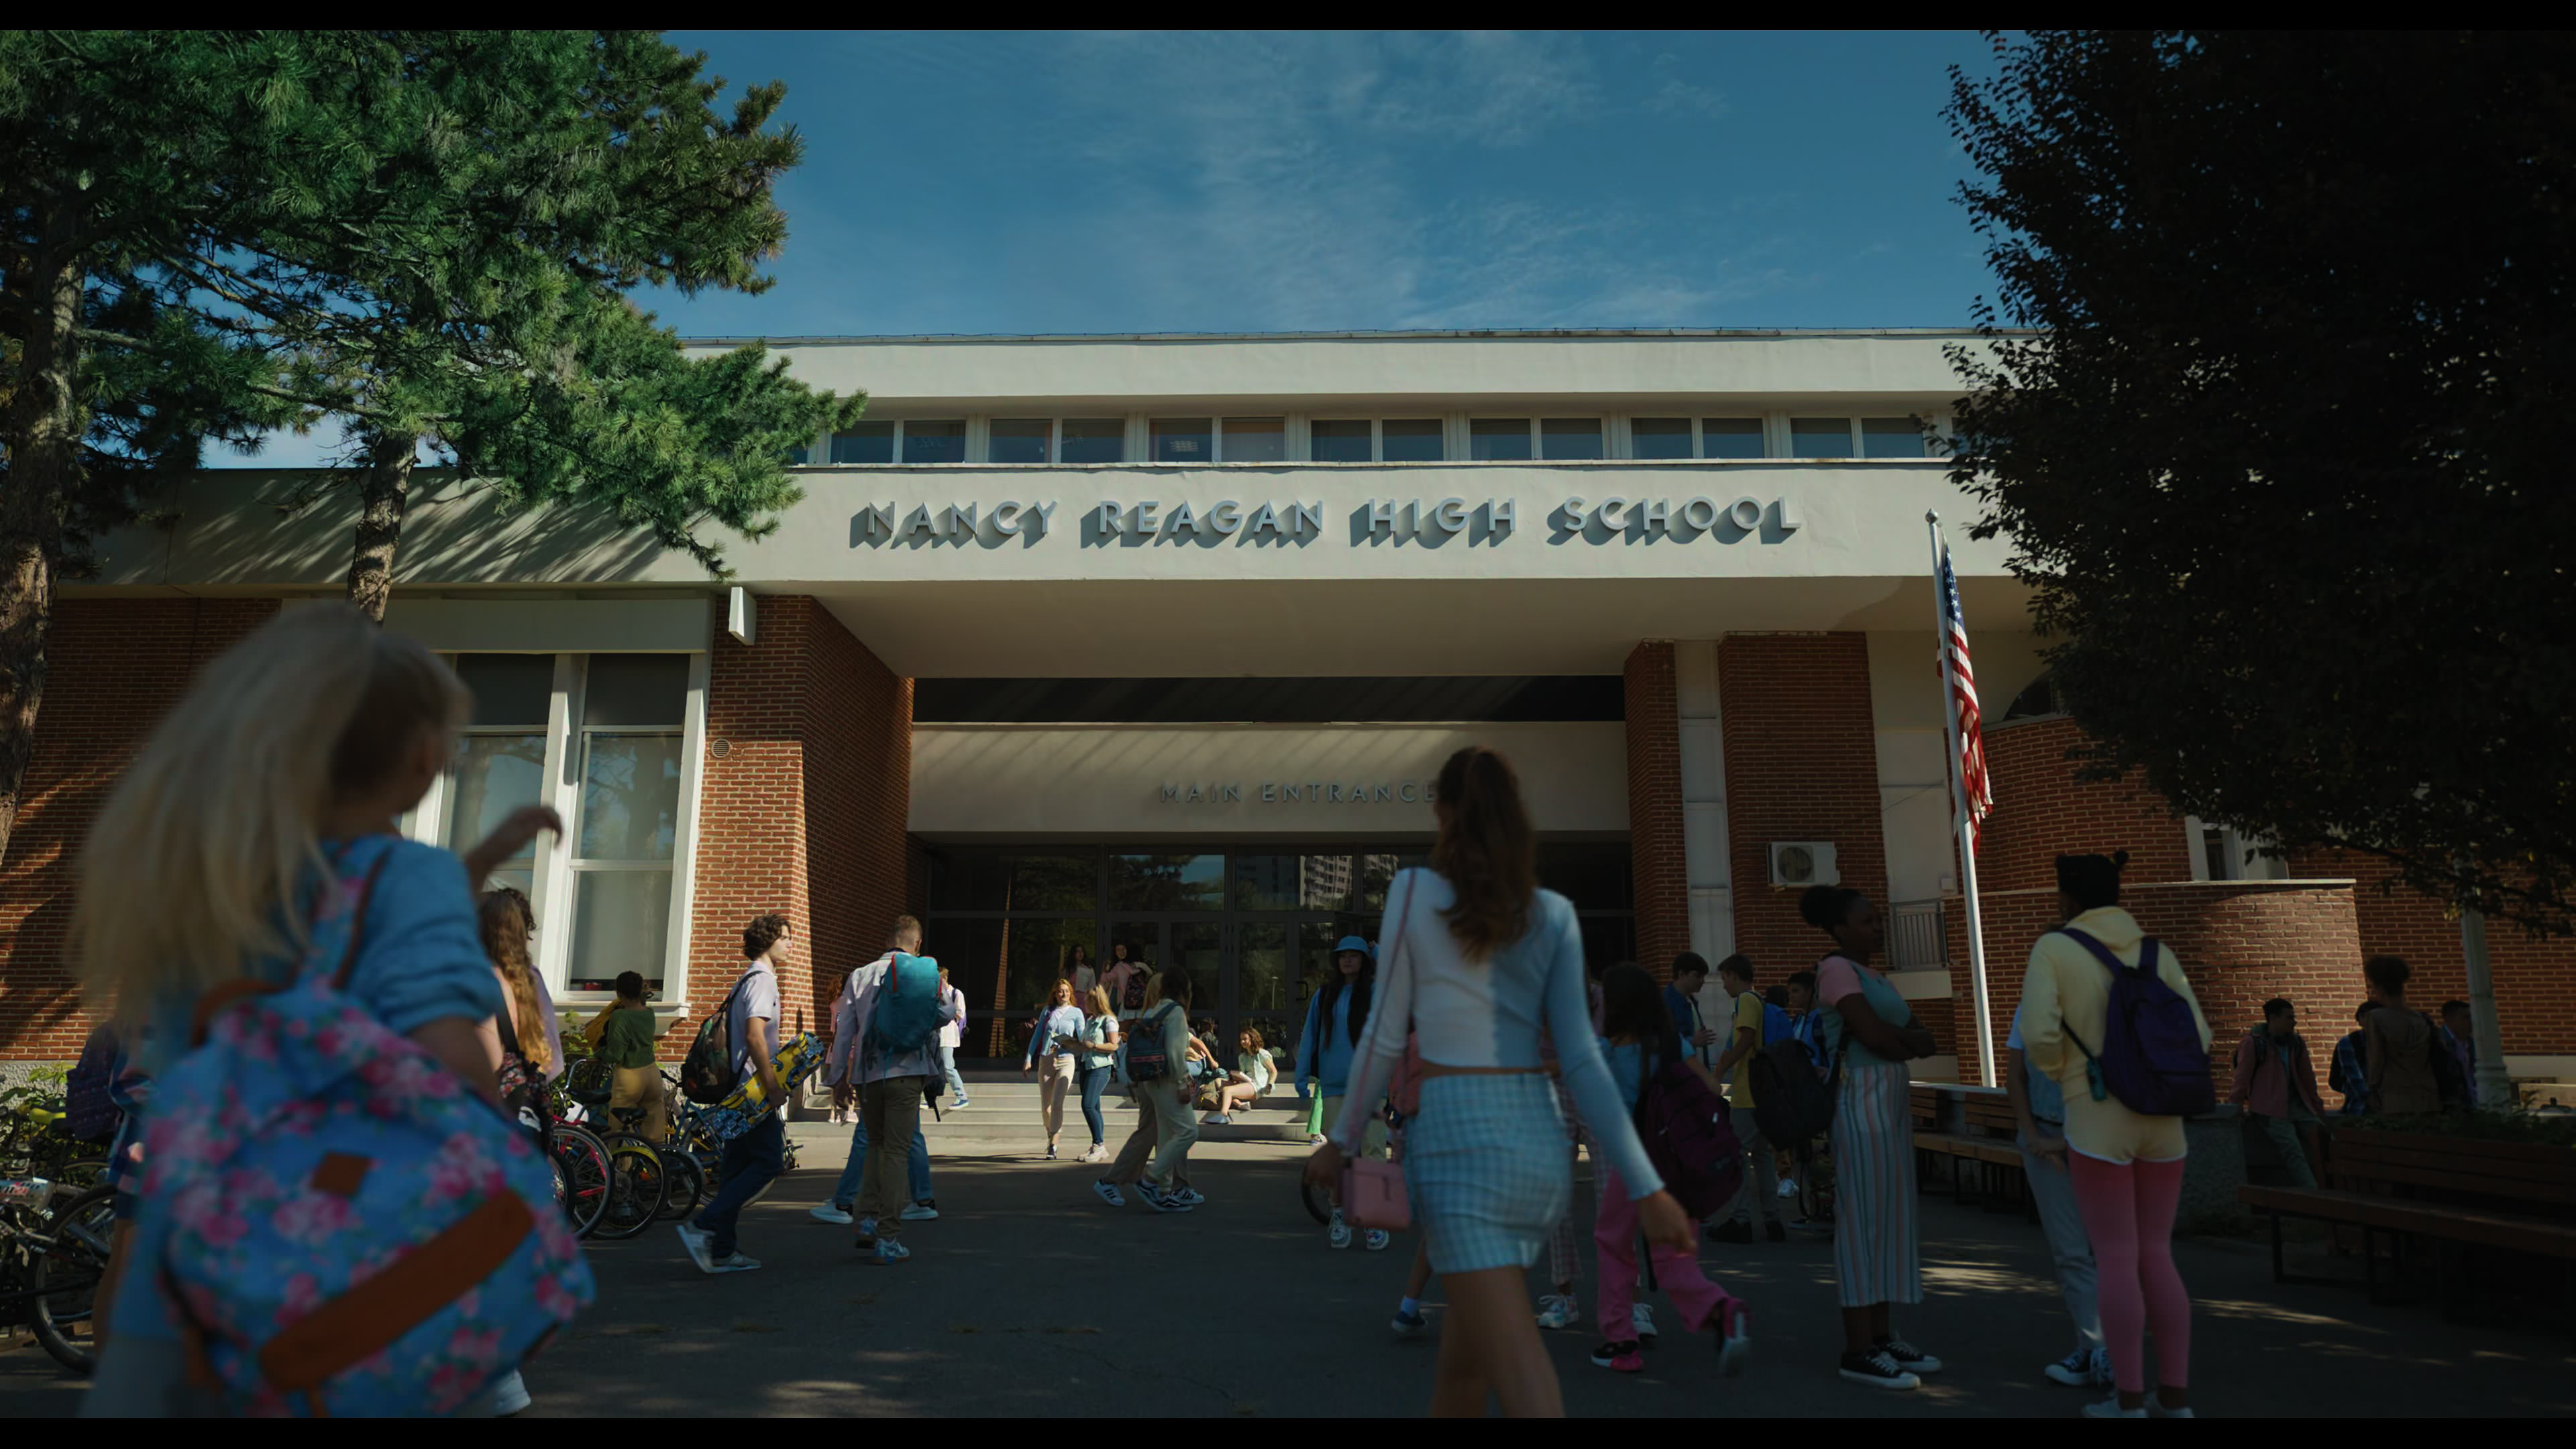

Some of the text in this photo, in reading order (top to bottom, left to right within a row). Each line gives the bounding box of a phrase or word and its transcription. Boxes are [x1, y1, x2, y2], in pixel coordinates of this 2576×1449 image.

[867, 496, 1802, 535] NANCY REAGAN HIGH SCHOOL
[1161, 782, 1436, 803] MAIN ENTRANCE
